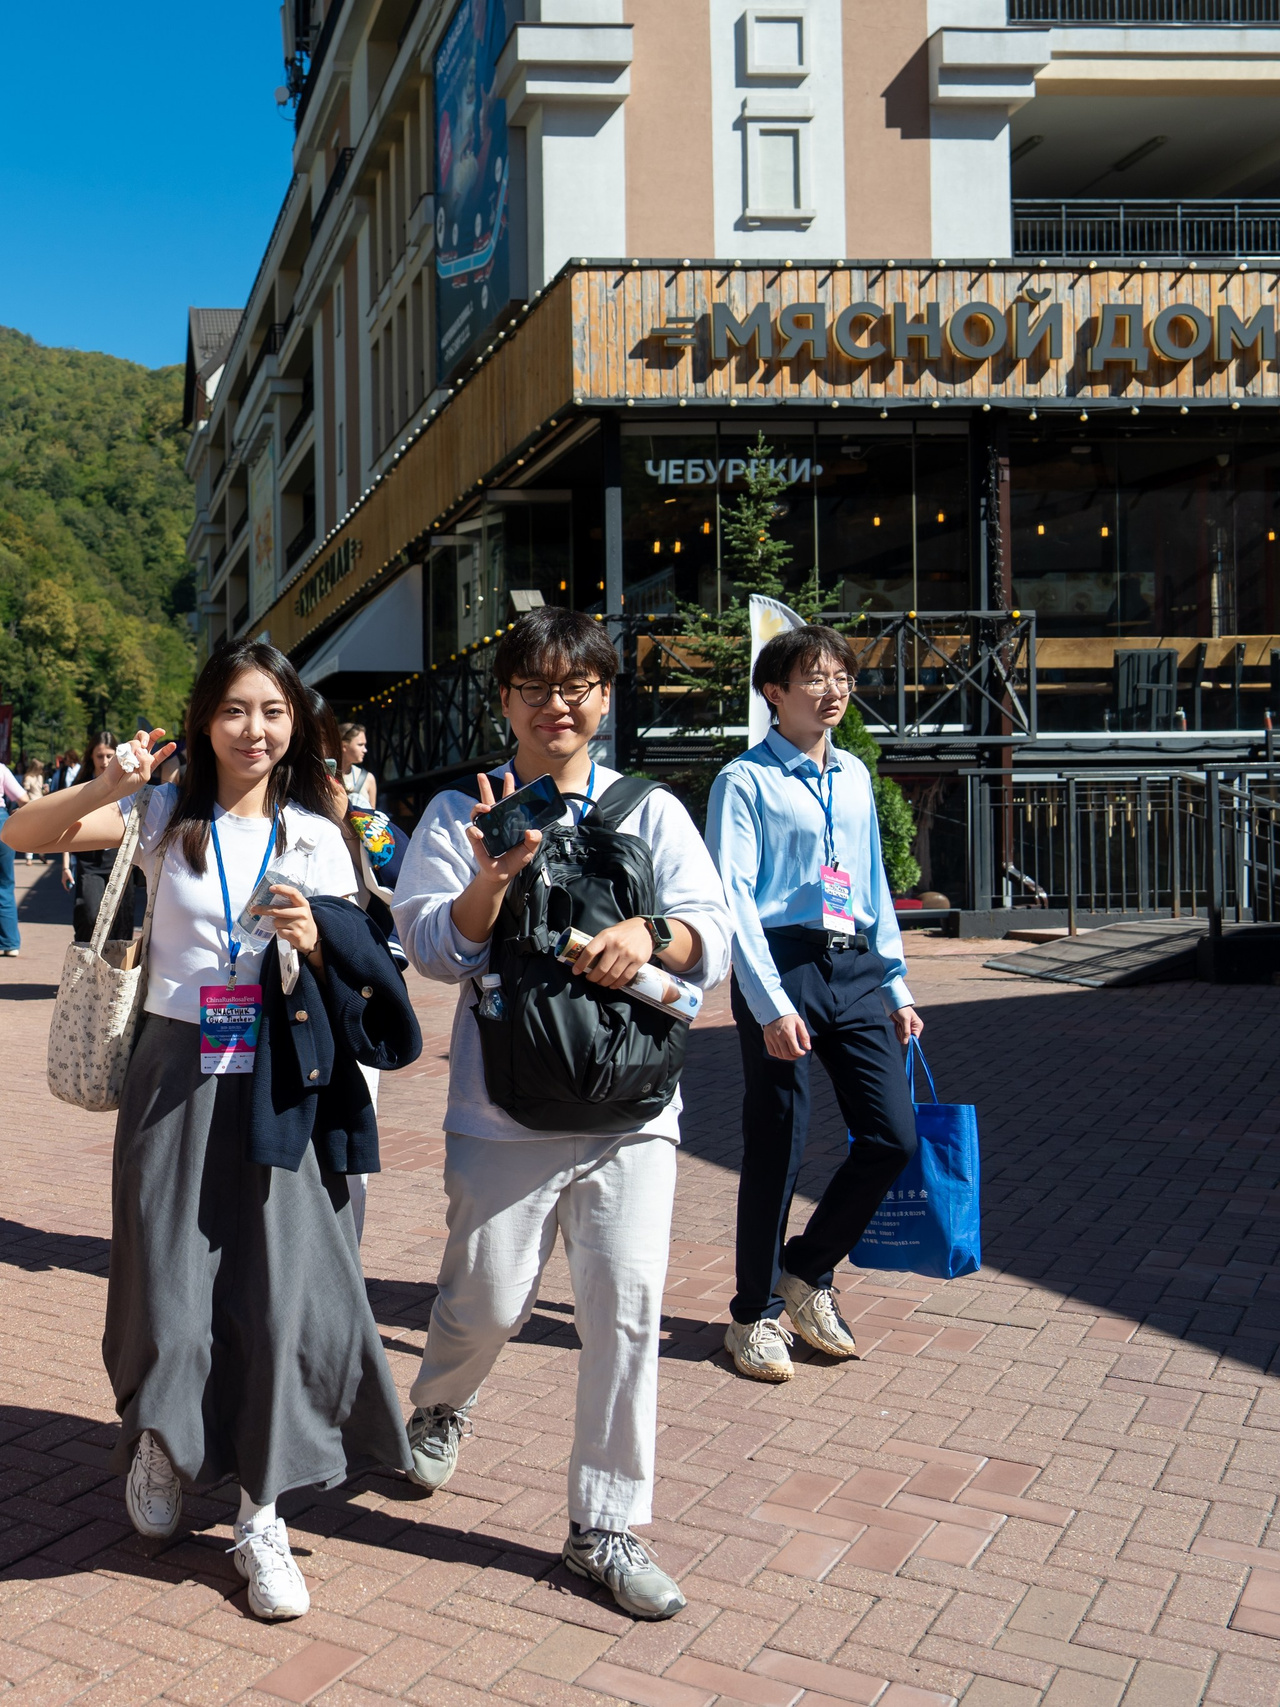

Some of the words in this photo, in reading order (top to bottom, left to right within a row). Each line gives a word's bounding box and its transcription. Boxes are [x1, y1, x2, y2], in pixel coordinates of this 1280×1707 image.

[711, 286, 1063, 361] МЯСНОЙ
[1086, 302, 1278, 373] ДОМ
[645, 458, 812, 485] ЧЕБУРЕКИ
